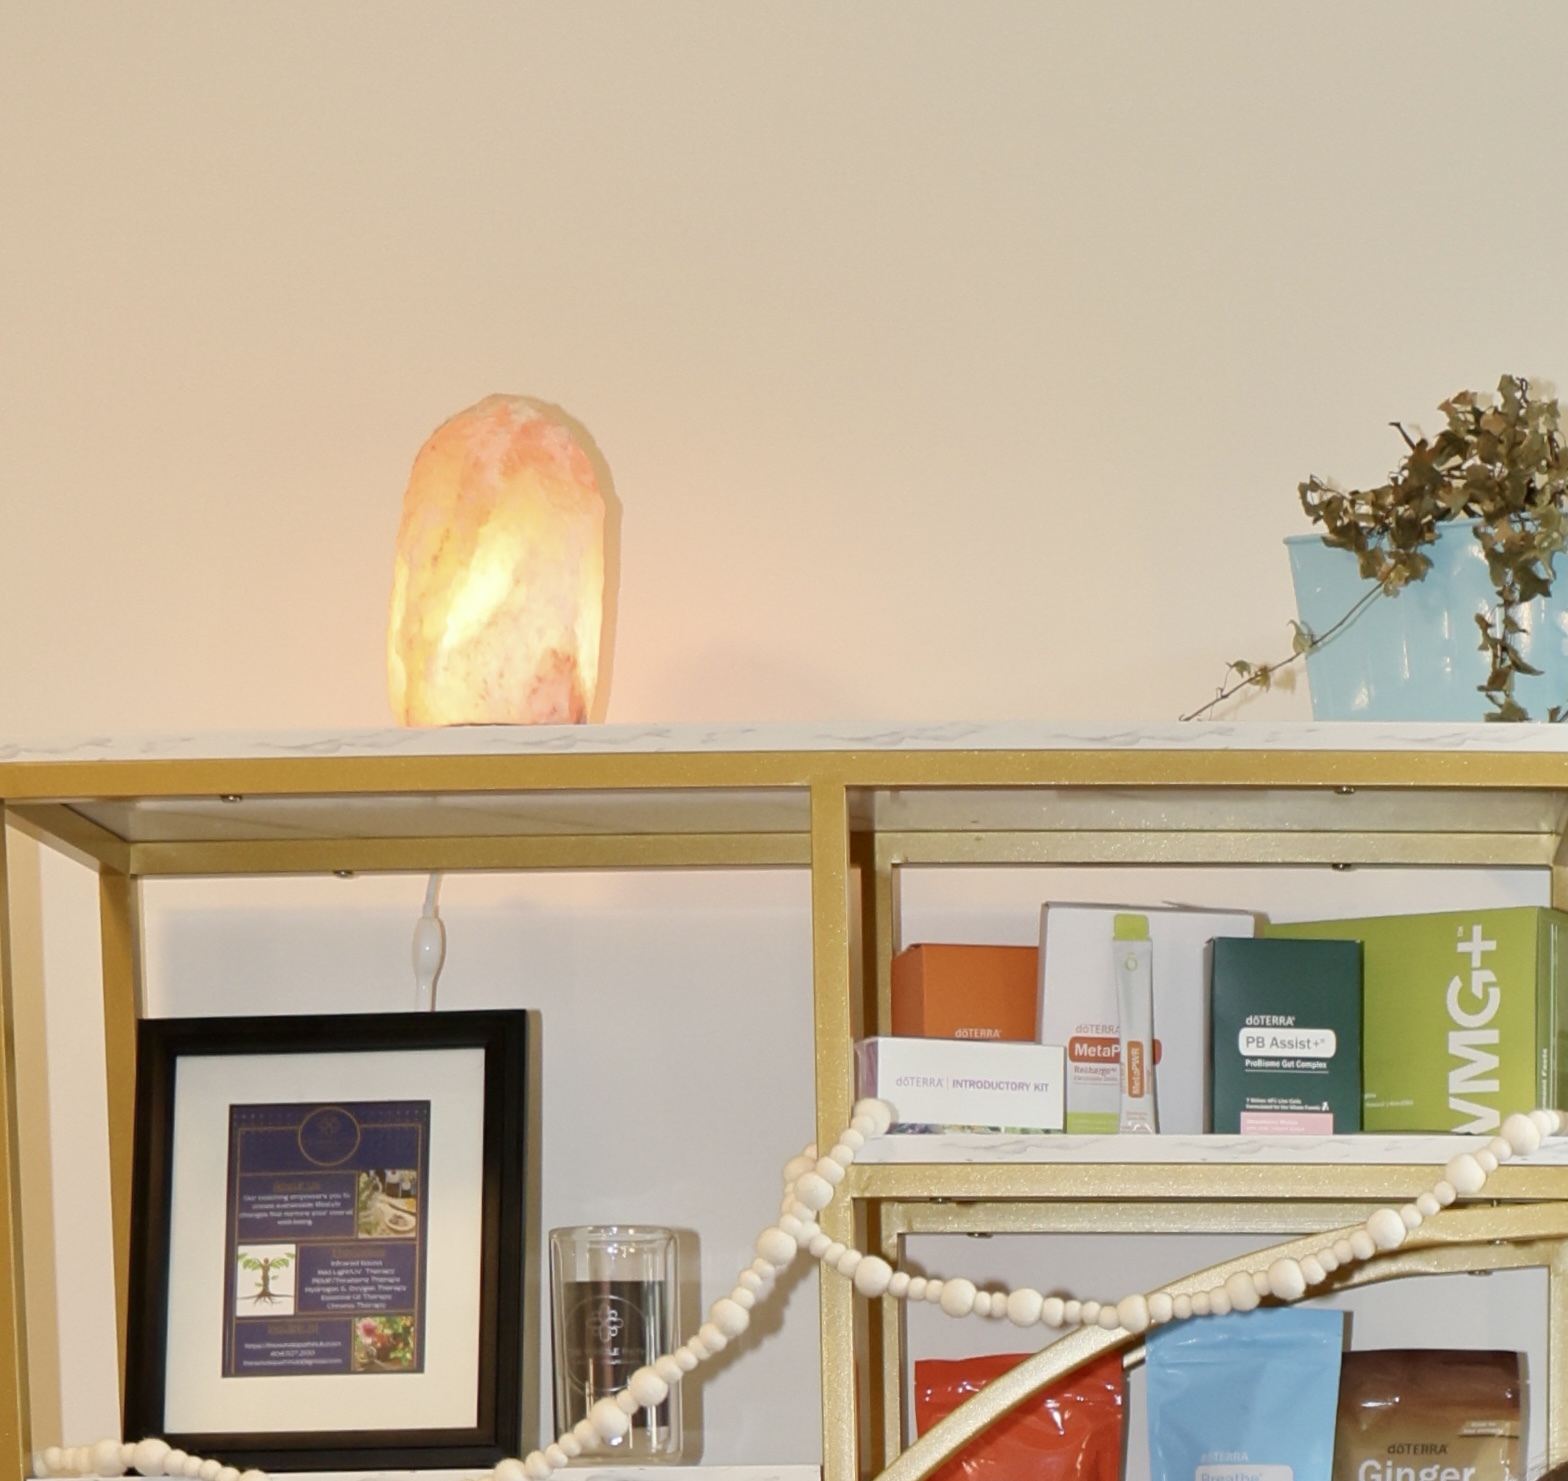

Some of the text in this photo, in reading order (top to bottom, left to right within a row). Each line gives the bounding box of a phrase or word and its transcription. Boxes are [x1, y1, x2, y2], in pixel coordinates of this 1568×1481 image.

[1245, 1036, 1266, 1049] PB
[1074, 1043, 1120, 1058] MetaP
[952, 1079, 1031, 1092] INTRODUCTORY
[1033, 1082, 1050, 1093] KIT
